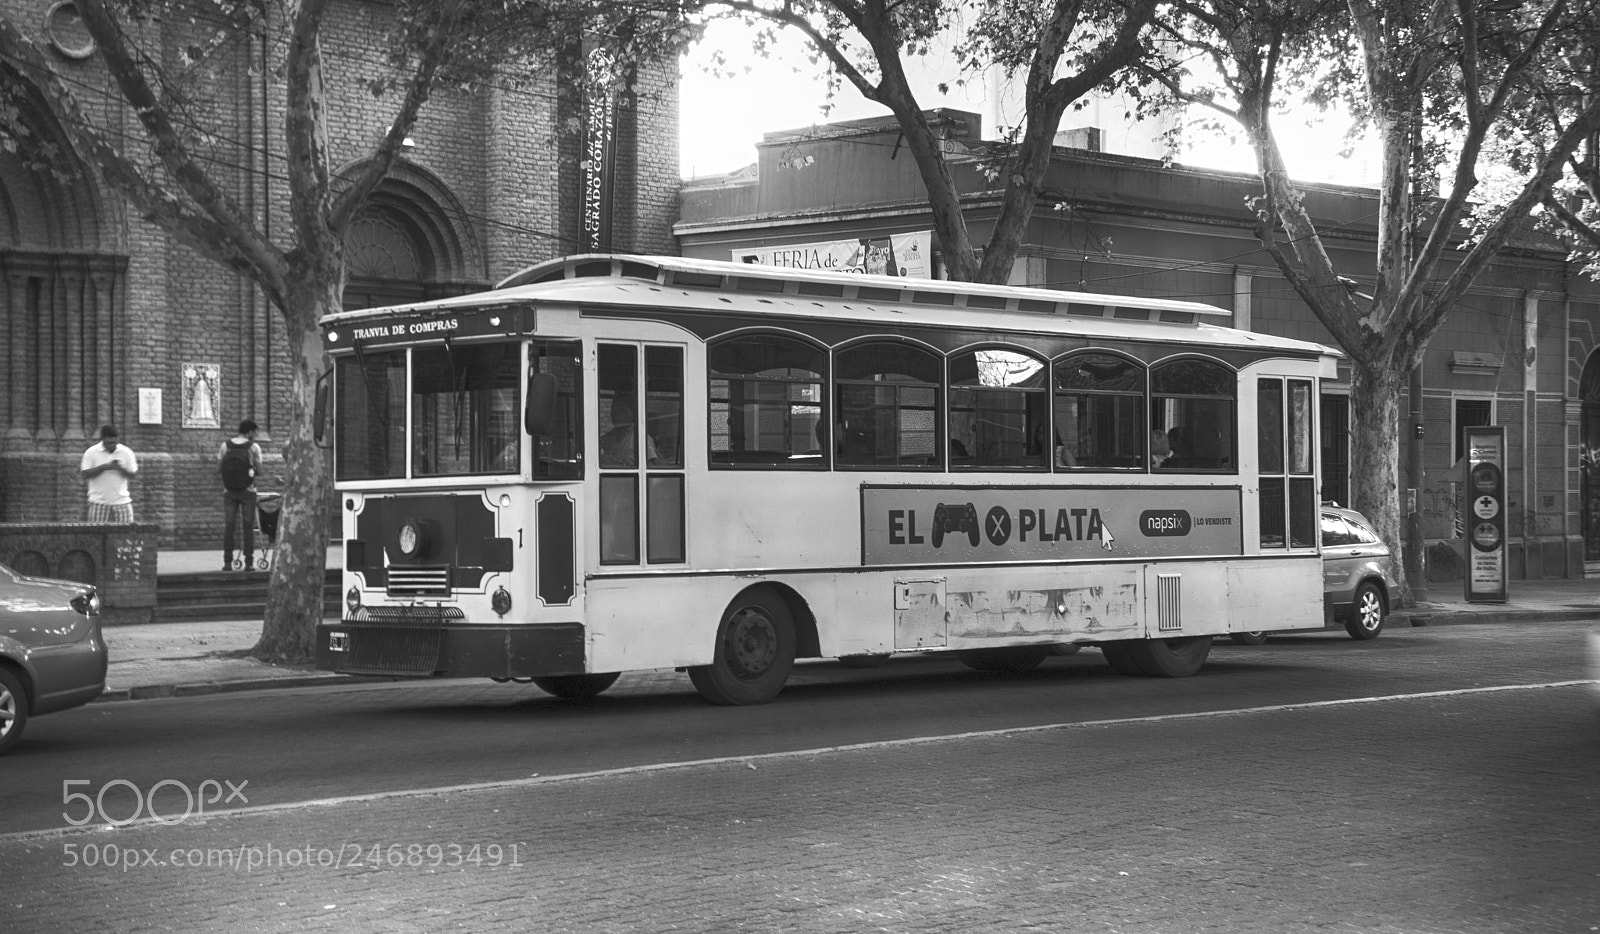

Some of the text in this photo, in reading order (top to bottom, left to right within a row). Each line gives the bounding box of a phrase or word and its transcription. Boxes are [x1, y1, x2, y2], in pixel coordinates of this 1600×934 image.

[584, 159, 593, 231] CENTENARIO
[591, 177, 602, 249] SAGRADO
[773, 249, 838, 269] FERIA de
[353, 319, 458, 339] TRANVIA DE COMPRAS
[888, 509, 924, 545] EL
[1019, 508, 1103, 542] PLATA
[1147, 513, 1183, 533] napsix
[517, 528, 523, 549] 1
